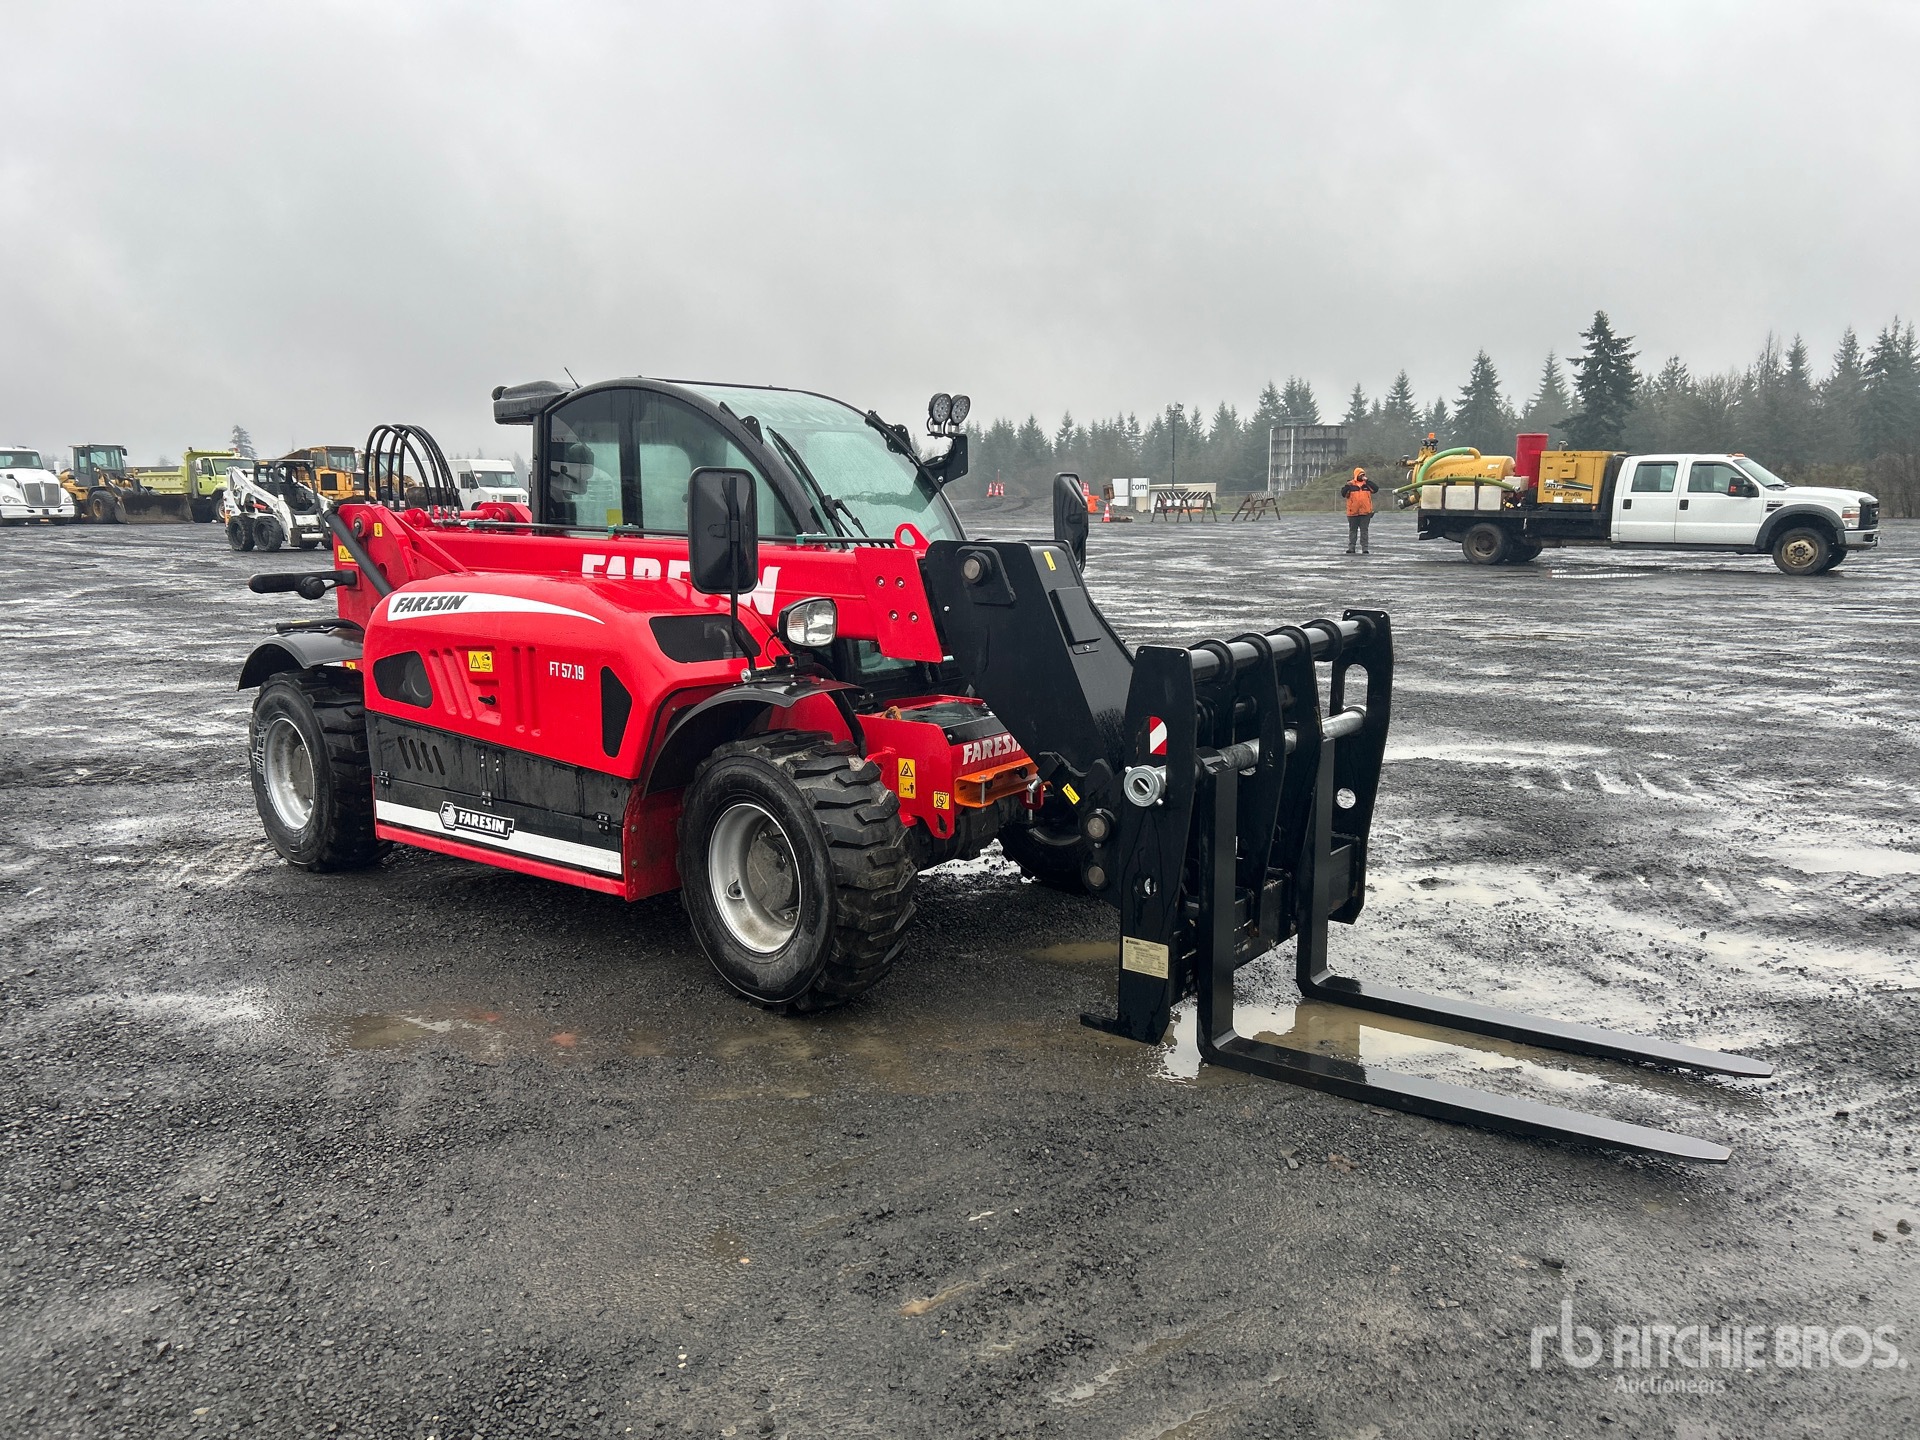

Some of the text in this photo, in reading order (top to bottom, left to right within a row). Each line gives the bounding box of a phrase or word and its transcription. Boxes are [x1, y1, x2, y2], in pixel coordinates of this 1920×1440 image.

[582, 554, 782, 616] FARN
[392, 595, 469, 613] FARESIN
[549, 661, 585, 681] FT 57.19
[962, 734, 1022, 766] FARESI
[458, 810, 506, 833] FARESIN
